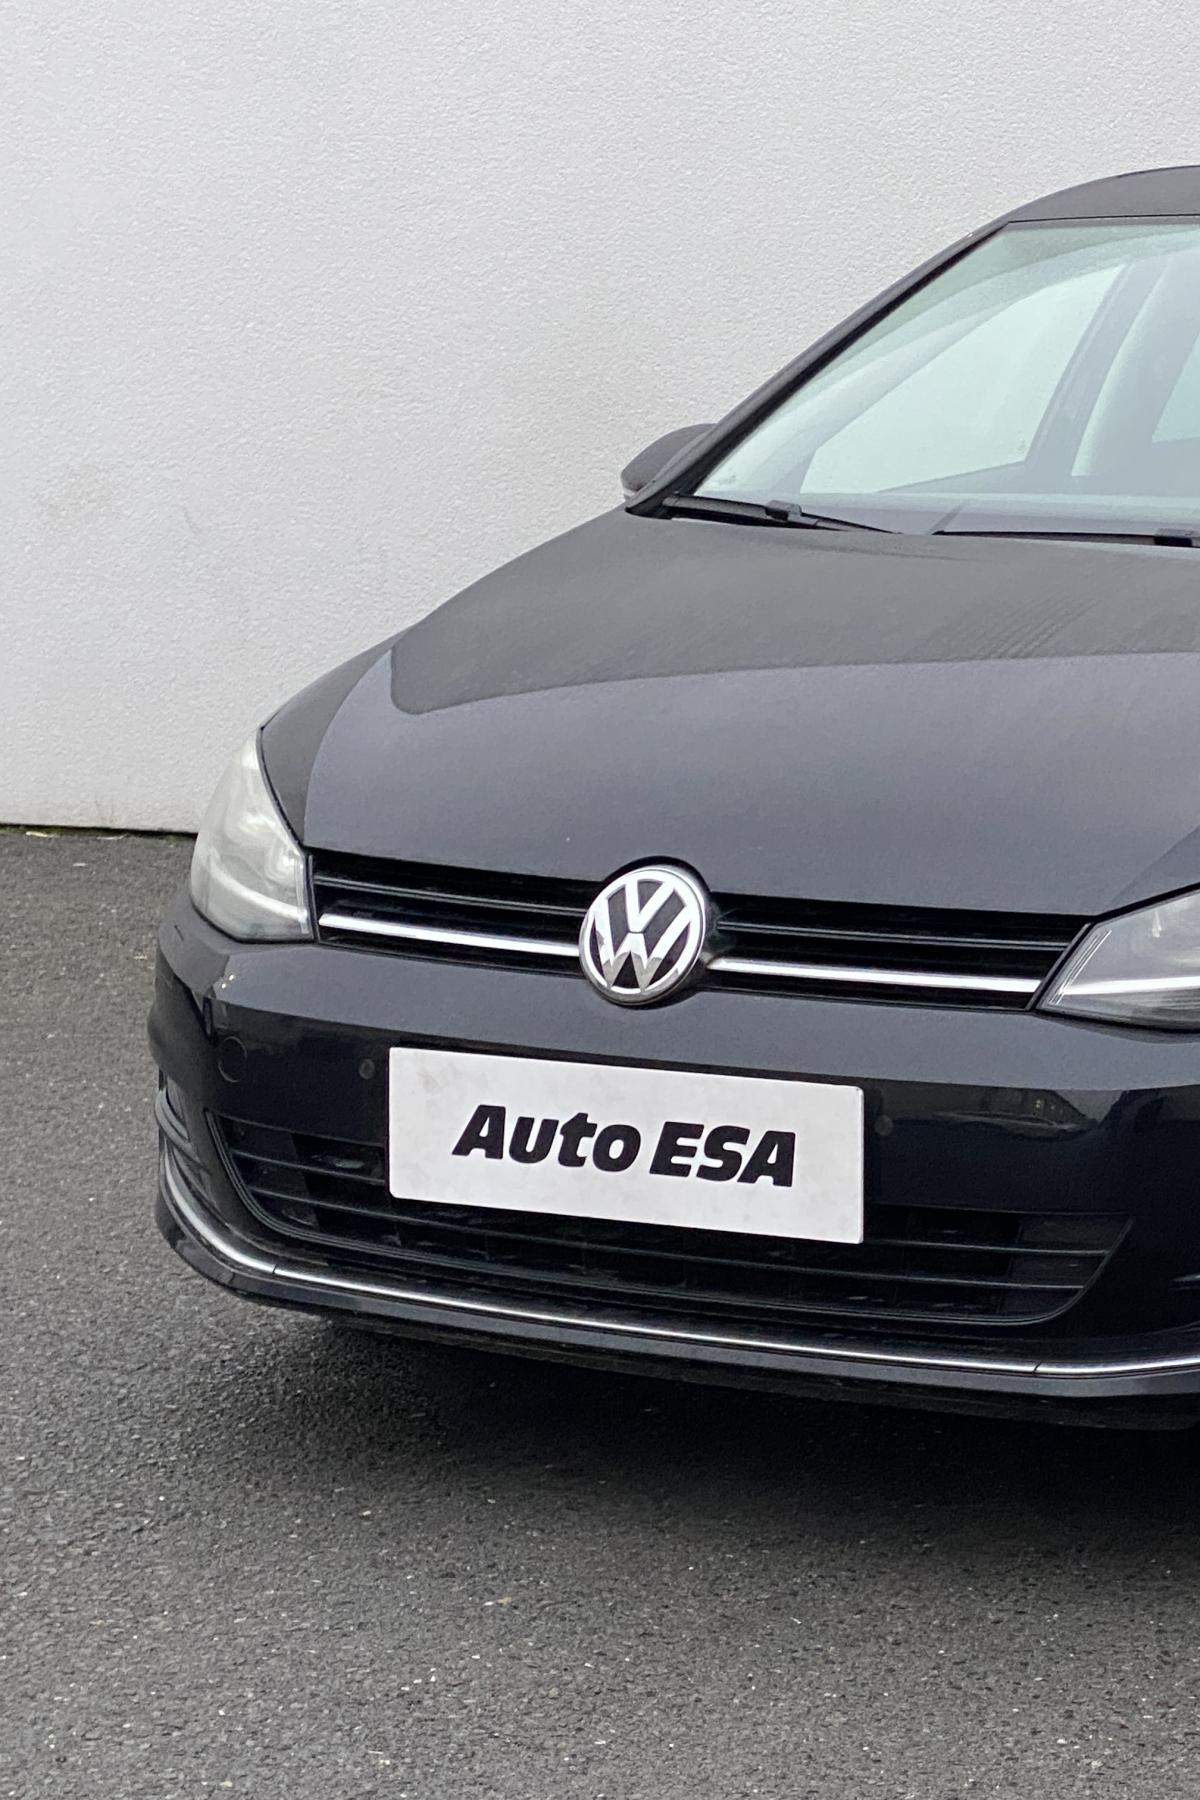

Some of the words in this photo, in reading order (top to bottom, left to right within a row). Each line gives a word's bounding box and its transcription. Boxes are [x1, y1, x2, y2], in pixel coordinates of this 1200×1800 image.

[582, 867, 705, 998] VW
[451, 1104, 642, 1173] Auto
[649, 1121, 796, 1188] ESA
